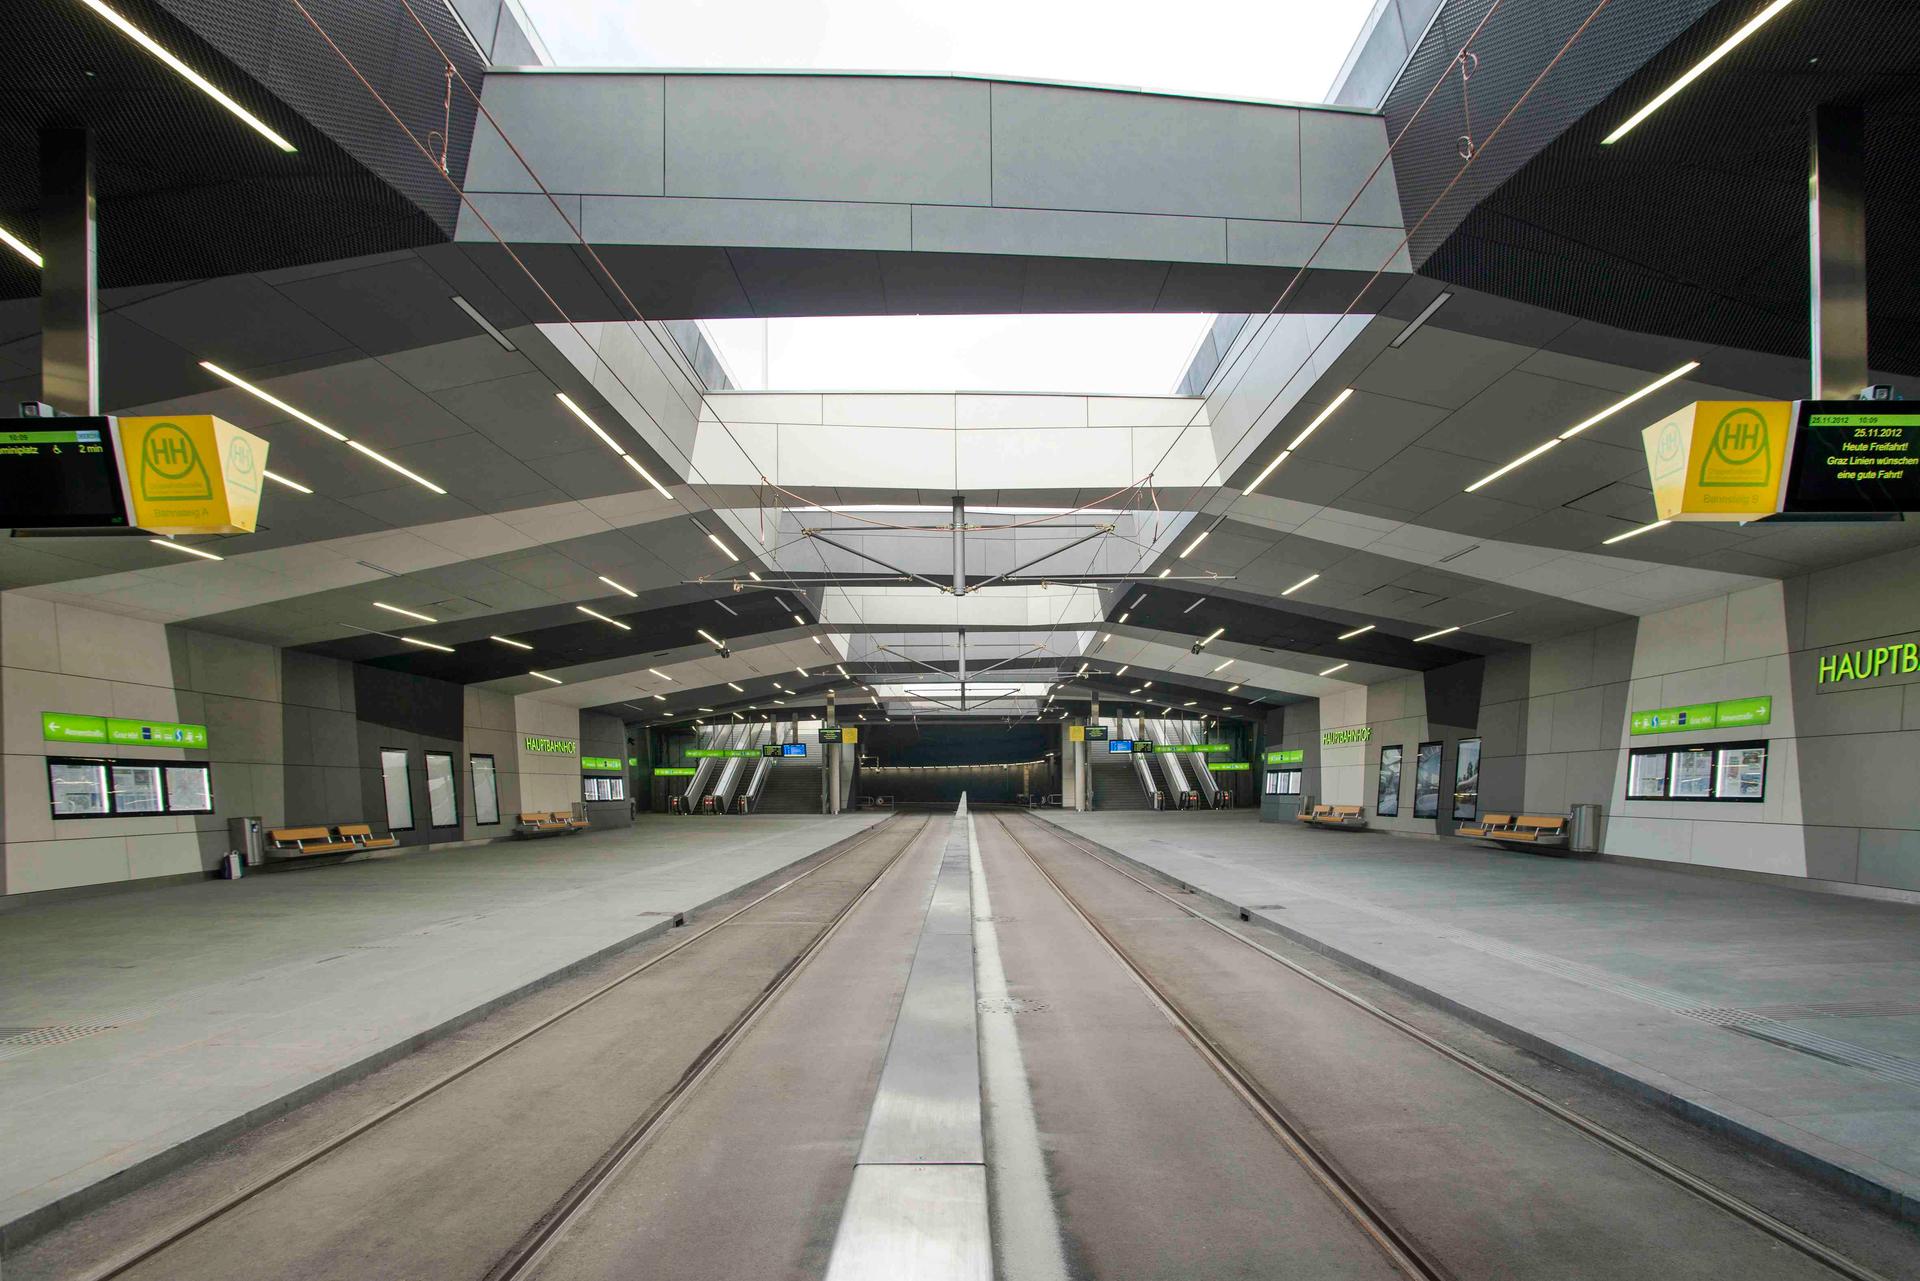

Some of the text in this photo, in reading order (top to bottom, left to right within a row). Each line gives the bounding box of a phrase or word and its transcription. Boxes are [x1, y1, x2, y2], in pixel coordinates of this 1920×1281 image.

[1811, 416, 1849, 424] 25.11.2012
[1854, 428, 1902, 437] 25.11.2012
[79, 444, 86, 453] 2
[87, 444, 103, 453] min
[1842, 442, 1908, 451] Heute Freifahrt!
[1827, 456, 1919, 465] Graz Linien wünschen
[1837, 470, 1904, 481] eine gute Fahrt!
[1819, 643, 1920, 684] HAUPTB
[1323, 727, 1372, 745] HAUPTBAHNHOF
[526, 737, 576, 754] HAUPTBAHNHOF
